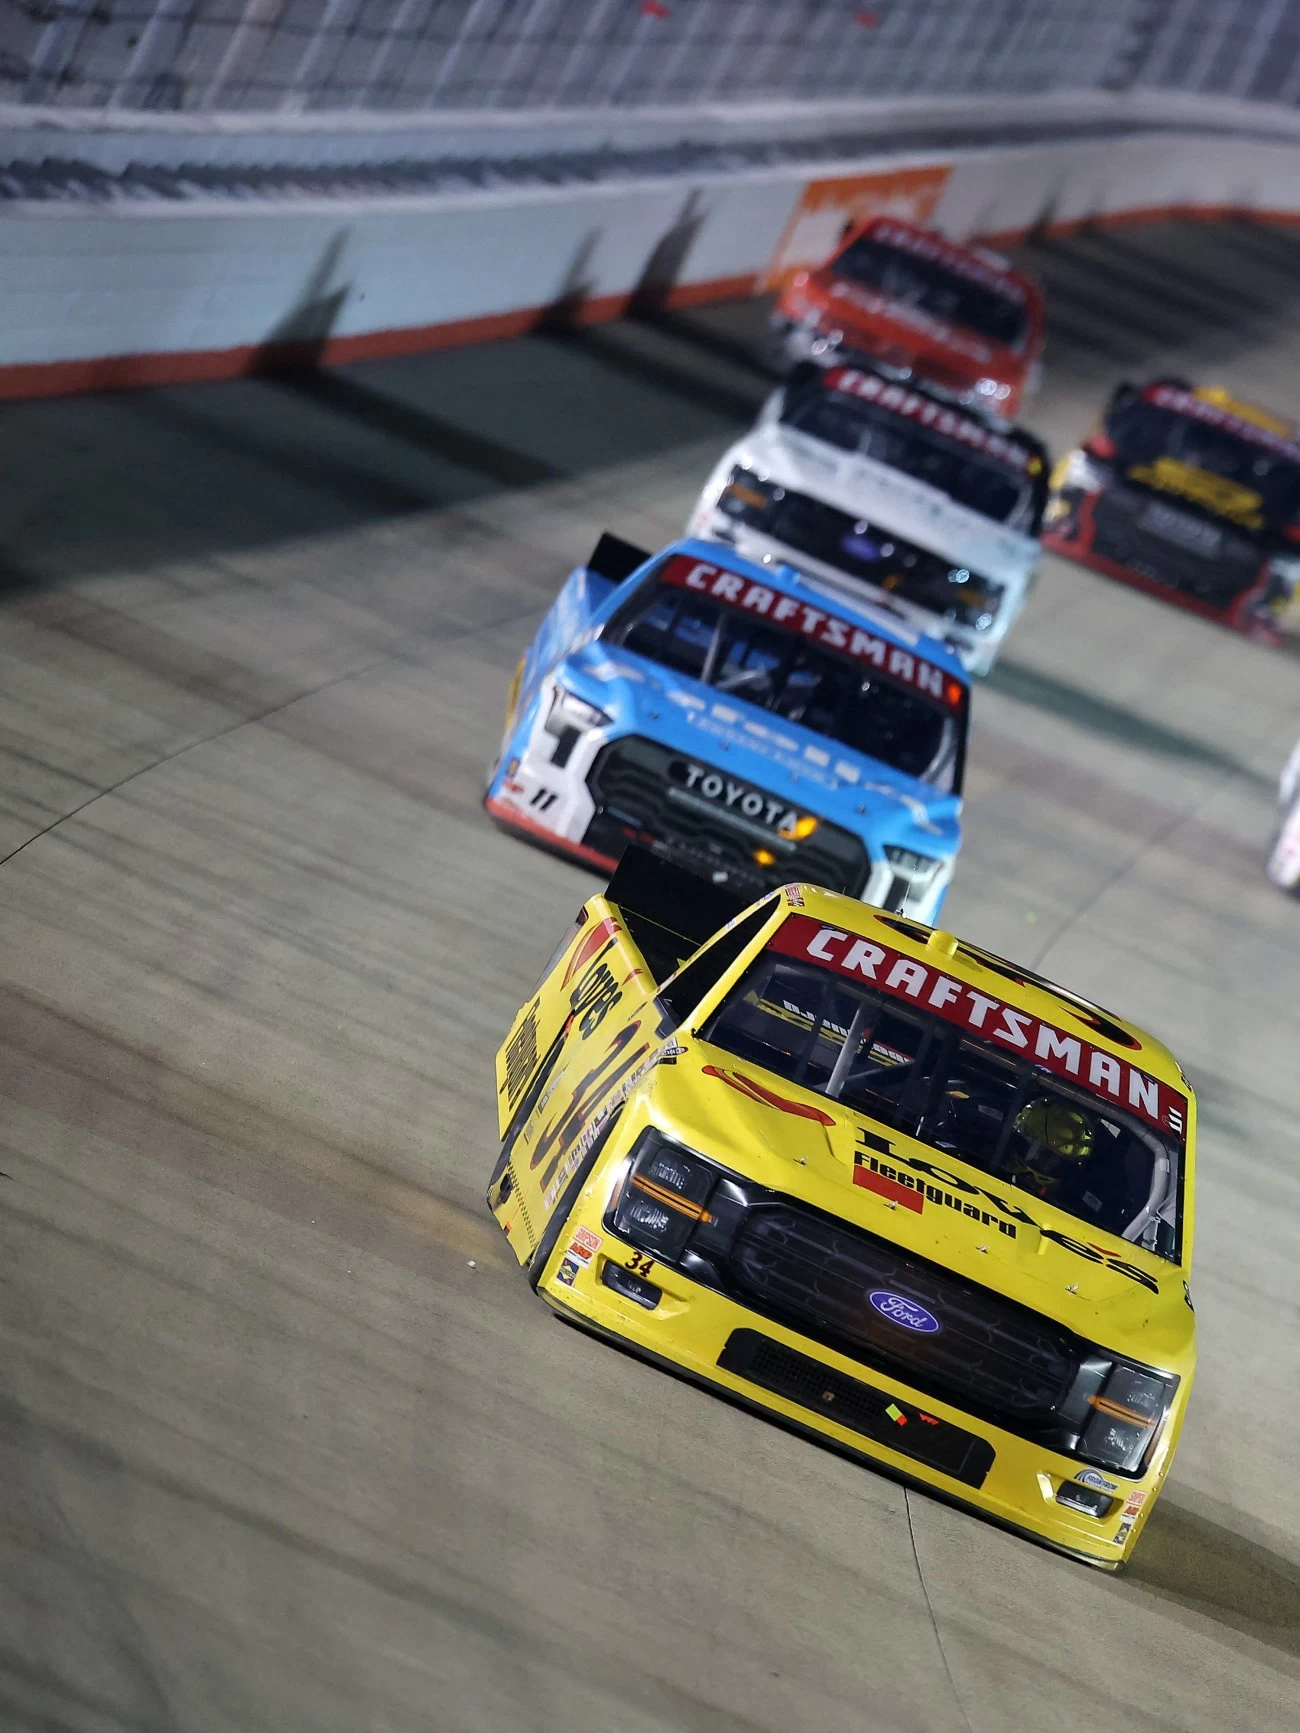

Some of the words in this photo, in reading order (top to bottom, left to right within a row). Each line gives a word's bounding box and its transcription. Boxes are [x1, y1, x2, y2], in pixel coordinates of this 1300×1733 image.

[685, 563, 944, 698] CRAFTSMAN
[529, 788, 558, 812] 11
[687, 764, 798, 833] TOYOTA
[806, 927, 1160, 1120] CRAFTSMAN
[853, 1150, 1017, 1240] Fleetguard
[624, 1251, 655, 1278] 34
[880, 1297, 928, 1328] Ford
